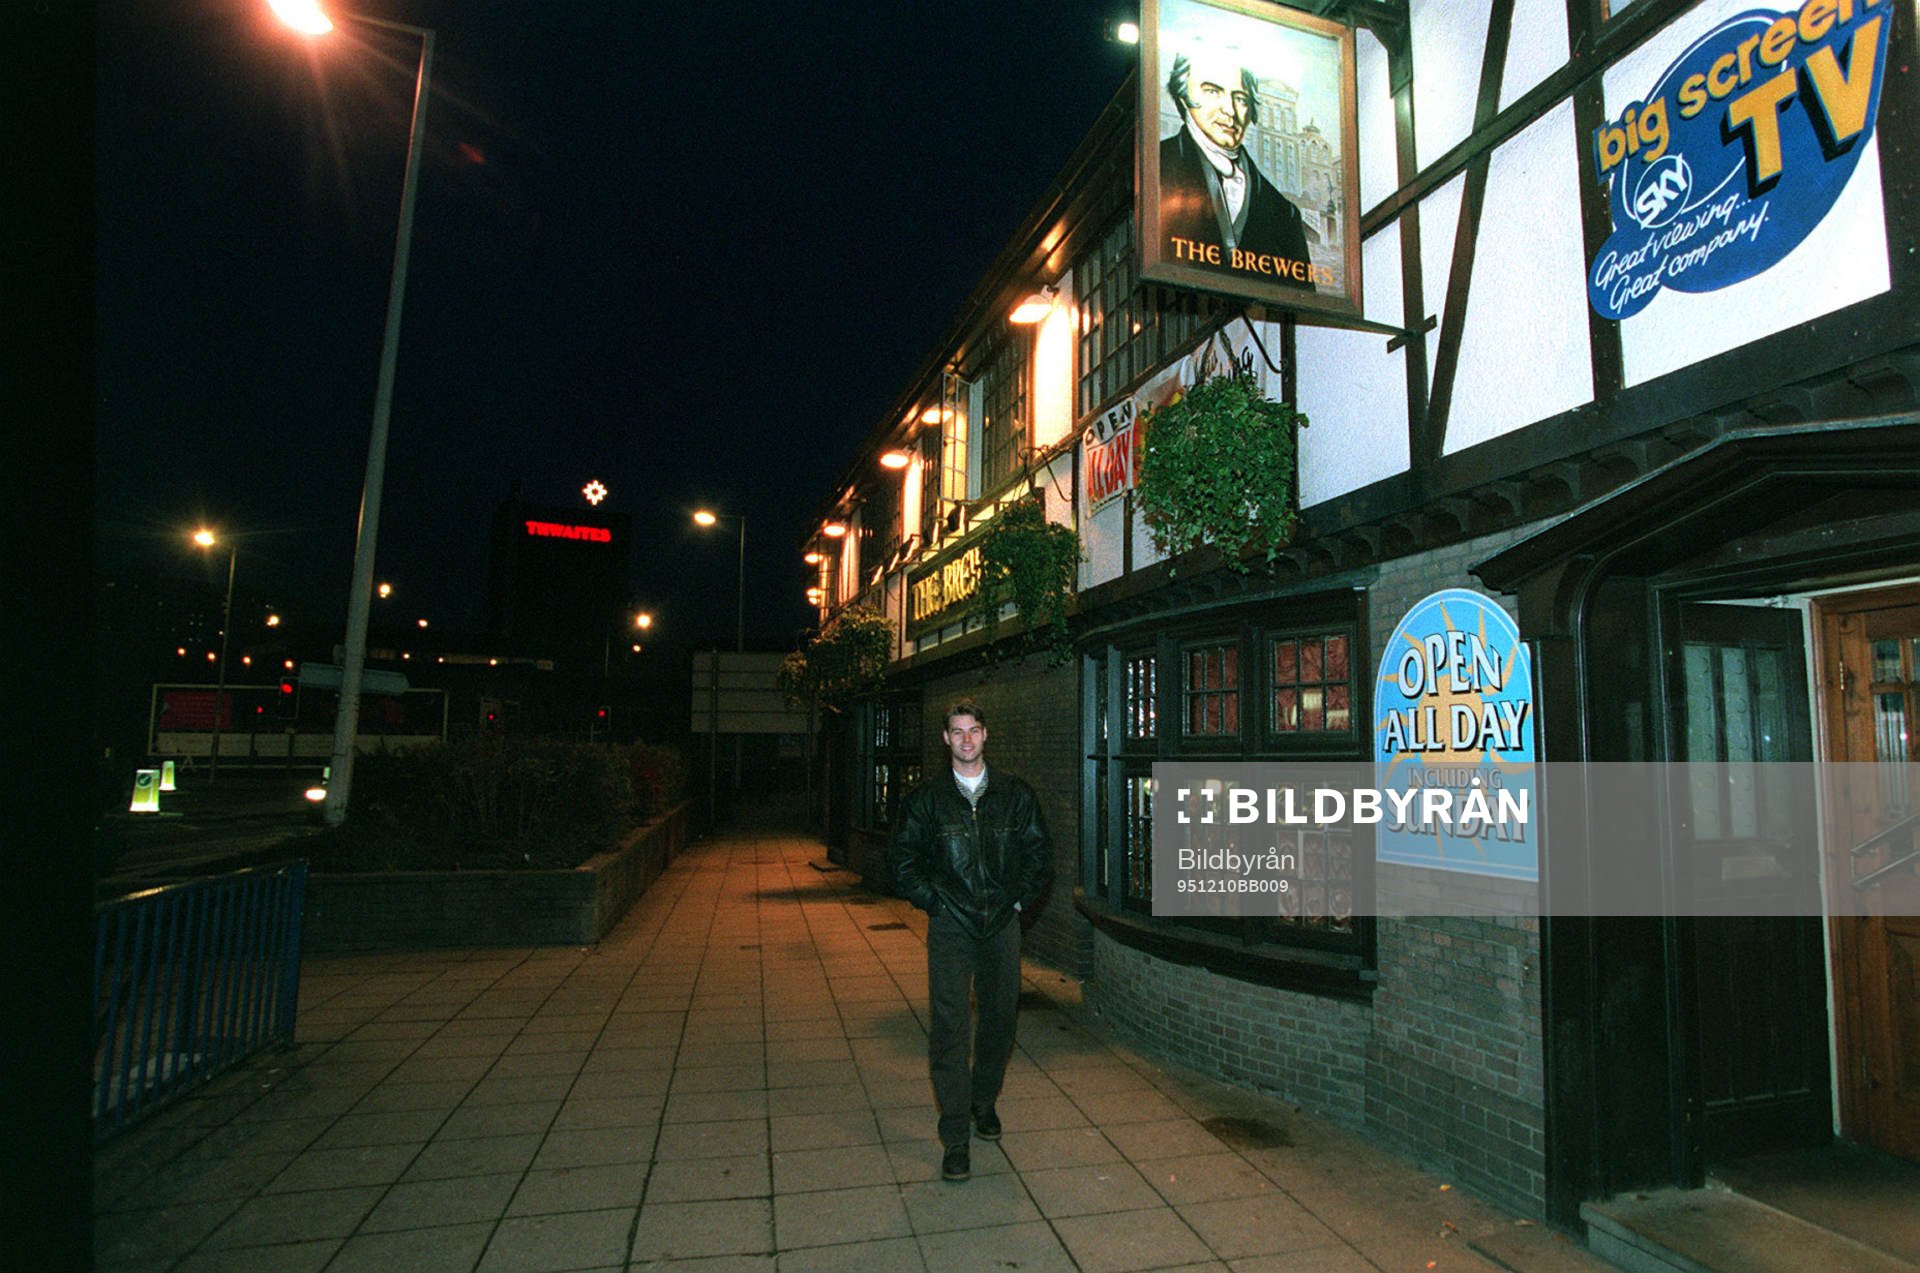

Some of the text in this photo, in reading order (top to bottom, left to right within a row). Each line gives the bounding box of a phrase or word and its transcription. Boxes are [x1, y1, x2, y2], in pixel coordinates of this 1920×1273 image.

[1725, 16, 1882, 190] TV
[1596, 95, 1670, 174] big
[1635, 152, 1690, 230] SKY
[1170, 236, 1334, 286] THE BREWERS
[1594, 233, 1656, 291] Great
[1609, 201, 1770, 314] Great company.
[1085, 400, 1132, 446] OPEN
[1105, 430, 1132, 495] DAY
[525, 521, 611, 542] THWAITES
[912, 570, 941, 620] THE
[1397, 630, 1502, 700] OPEN
[1383, 699, 1529, 753] ALL DAY
[1407, 767, 1503, 790] INCLUDING
[1386, 792, 1530, 843] SUNDAY
